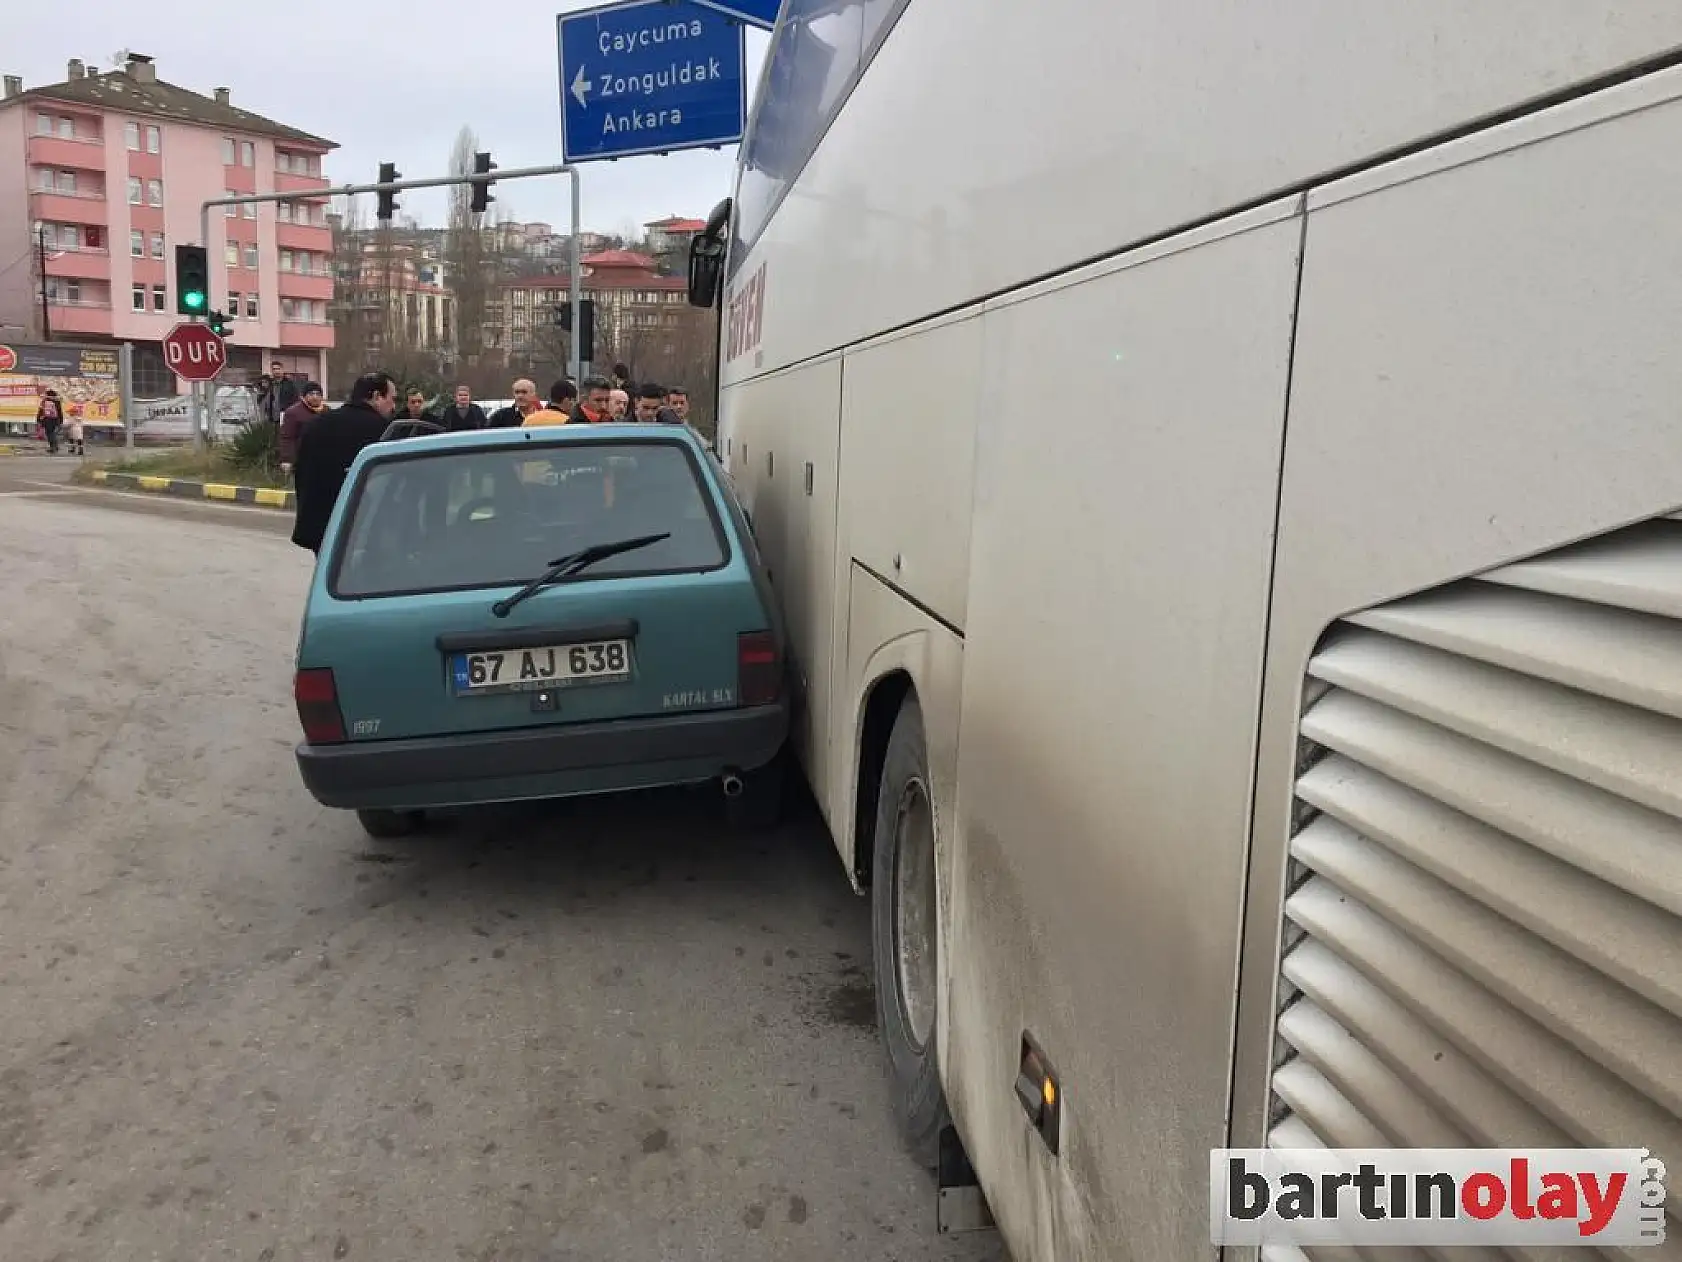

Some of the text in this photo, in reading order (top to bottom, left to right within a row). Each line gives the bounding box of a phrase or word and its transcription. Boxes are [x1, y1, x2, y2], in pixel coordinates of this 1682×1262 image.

[598, 19, 702, 56] Çaycuma
[600, 57, 721, 96] Zonguldak
[602, 108, 682, 135] Ankara
[169, 340, 220, 363] DUR
[469, 653, 504, 684] 67
[520, 648, 556, 680] AJ
[569, 643, 625, 674] 638
